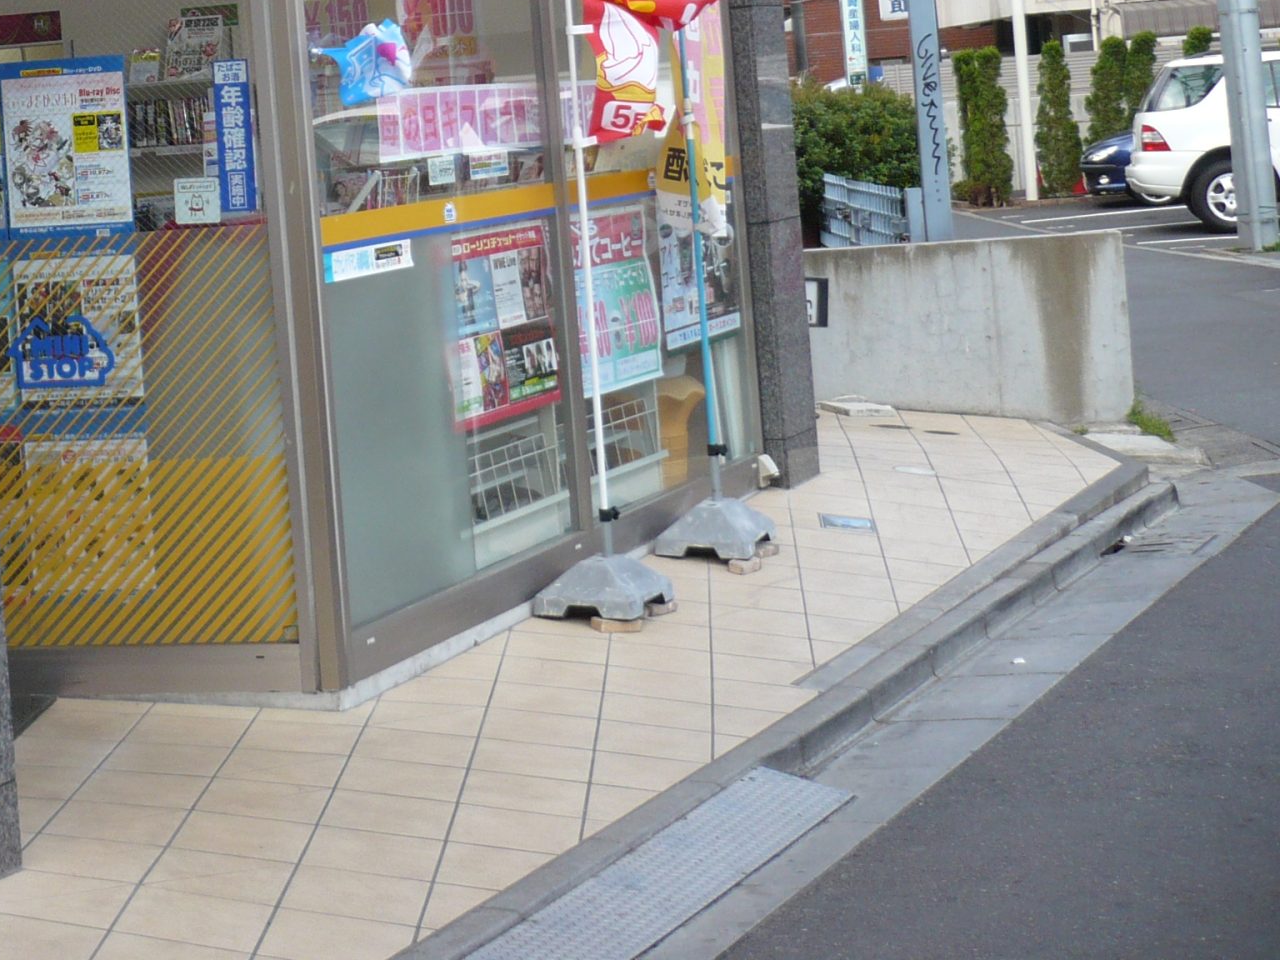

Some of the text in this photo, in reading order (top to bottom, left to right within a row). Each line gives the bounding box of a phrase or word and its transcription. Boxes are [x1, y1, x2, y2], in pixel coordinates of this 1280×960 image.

[217, 63, 243, 73] たばこ
[78, 86, 121, 98] Blu-ray Disc
[220, 85, 247, 171] 年齢確認
[31, 334, 89, 358] MINI
[29, 357, 95, 380] STOP
